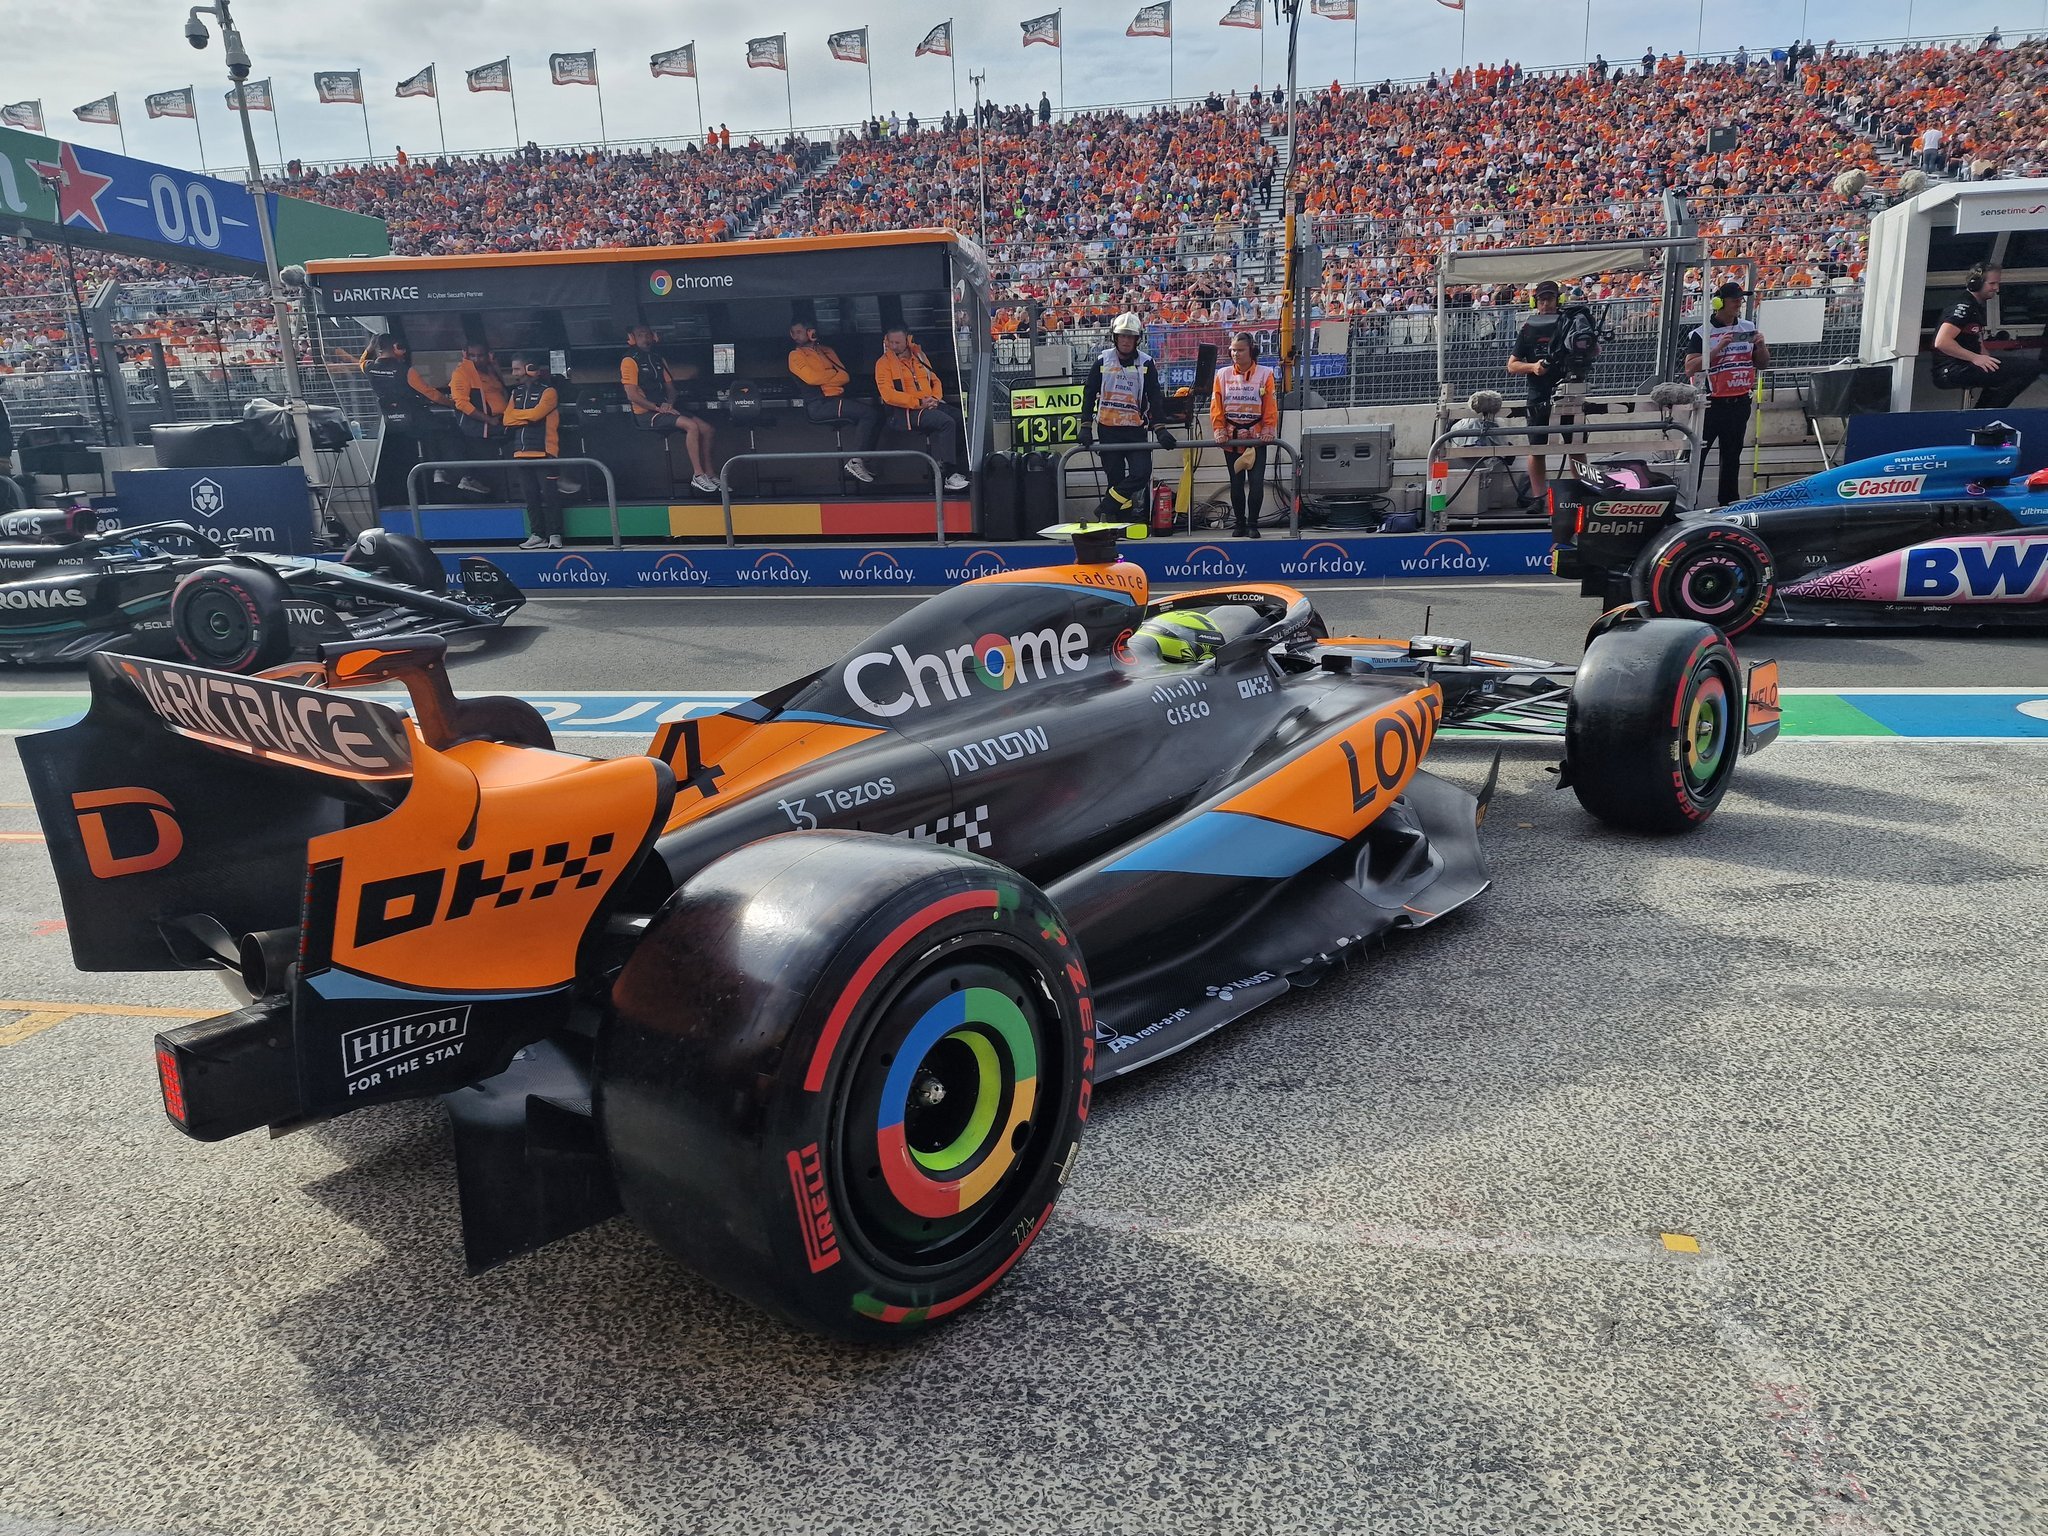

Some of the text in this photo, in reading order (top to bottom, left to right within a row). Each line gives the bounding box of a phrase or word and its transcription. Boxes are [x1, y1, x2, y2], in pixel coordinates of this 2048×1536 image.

[1980, 208, 2027, 216] sensetime
[676, 273, 733, 289] chrome
[333, 286, 419, 303] DARKTRACE
[1035, 393, 1082, 408] LAND
[1340, 460, 1350, 468] 24
[1884, 461, 1948, 473] E-TECH
[1895, 454, 1936, 463] RENAULT
[1858, 477, 1919, 496] Castrol
[1610, 501, 1664, 515] Castrol
[1587, 521, 1644, 536] Delphi
[1725, 532, 1769, 565] ZERO
[1803, 554, 1828, 564] ADA
[463, 570, 499, 583] INEOS
[1226, 593, 1265, 602] VELO.COM
[843, 622, 1089, 717] Chrome
[1236, 674, 1273, 700] OKX
[1166, 700, 1211, 726] cisco
[656, 719, 726, 799] 4
[816, 775, 896, 814] Tezos
[353, 832, 615, 949] OKX
[352, 1014, 458, 1064] Hilton
[1107, 1007, 1191, 1054] FAI rent-a-jet
[1065, 959, 1094, 1124] ZERO
[348, 1042, 464, 1096] FOR THE STAY
[786, 1142, 841, 1274] PIRELLI
